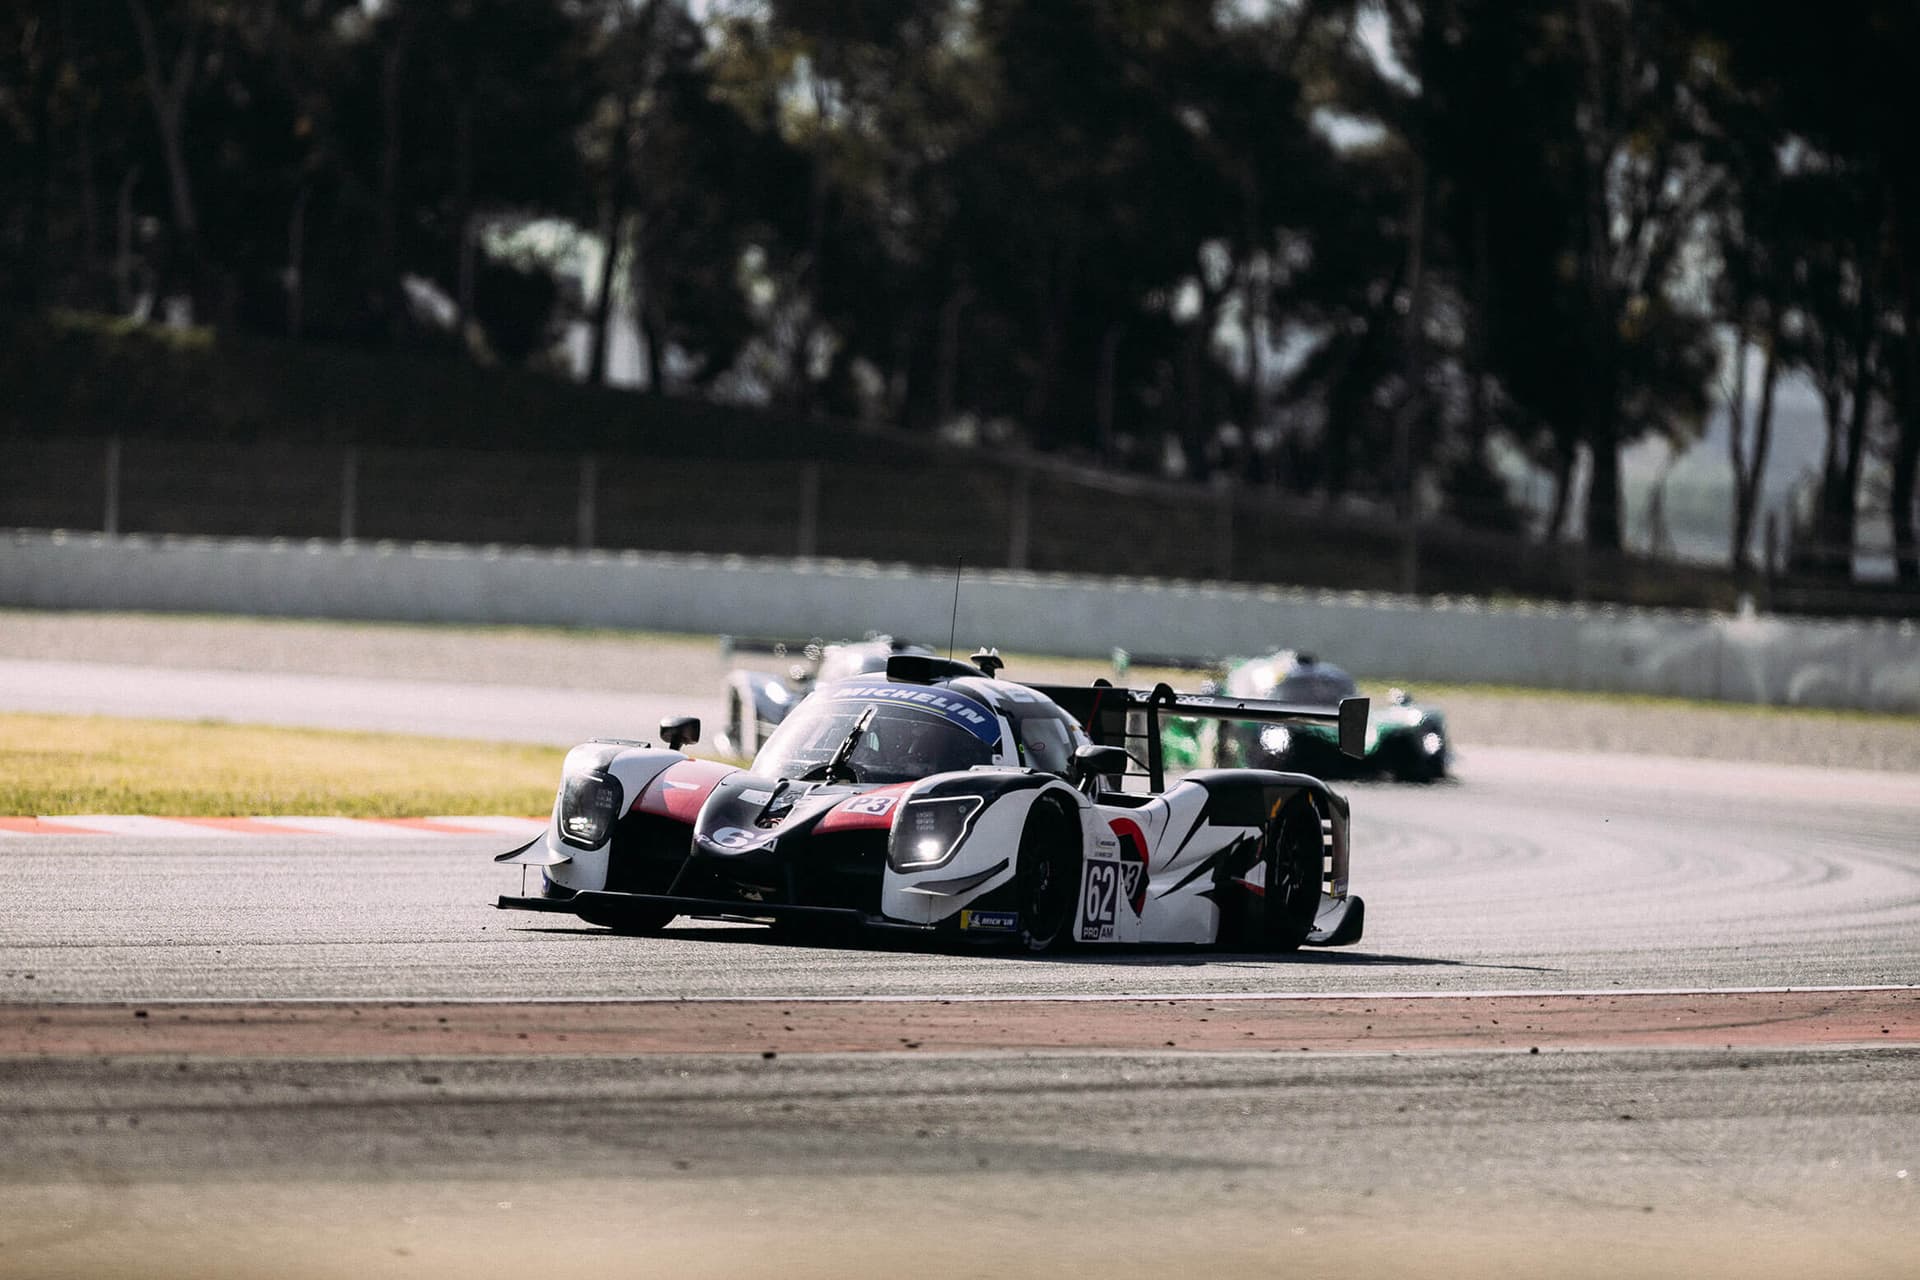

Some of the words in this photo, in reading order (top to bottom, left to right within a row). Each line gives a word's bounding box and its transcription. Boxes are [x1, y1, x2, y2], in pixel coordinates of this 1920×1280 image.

[832, 687, 986, 724] MICHELIN
[848, 797, 891, 812] P3
[1086, 866, 1115, 922] 62
[1083, 927, 1099, 938] PRO
[1101, 926, 1114, 938] AM
